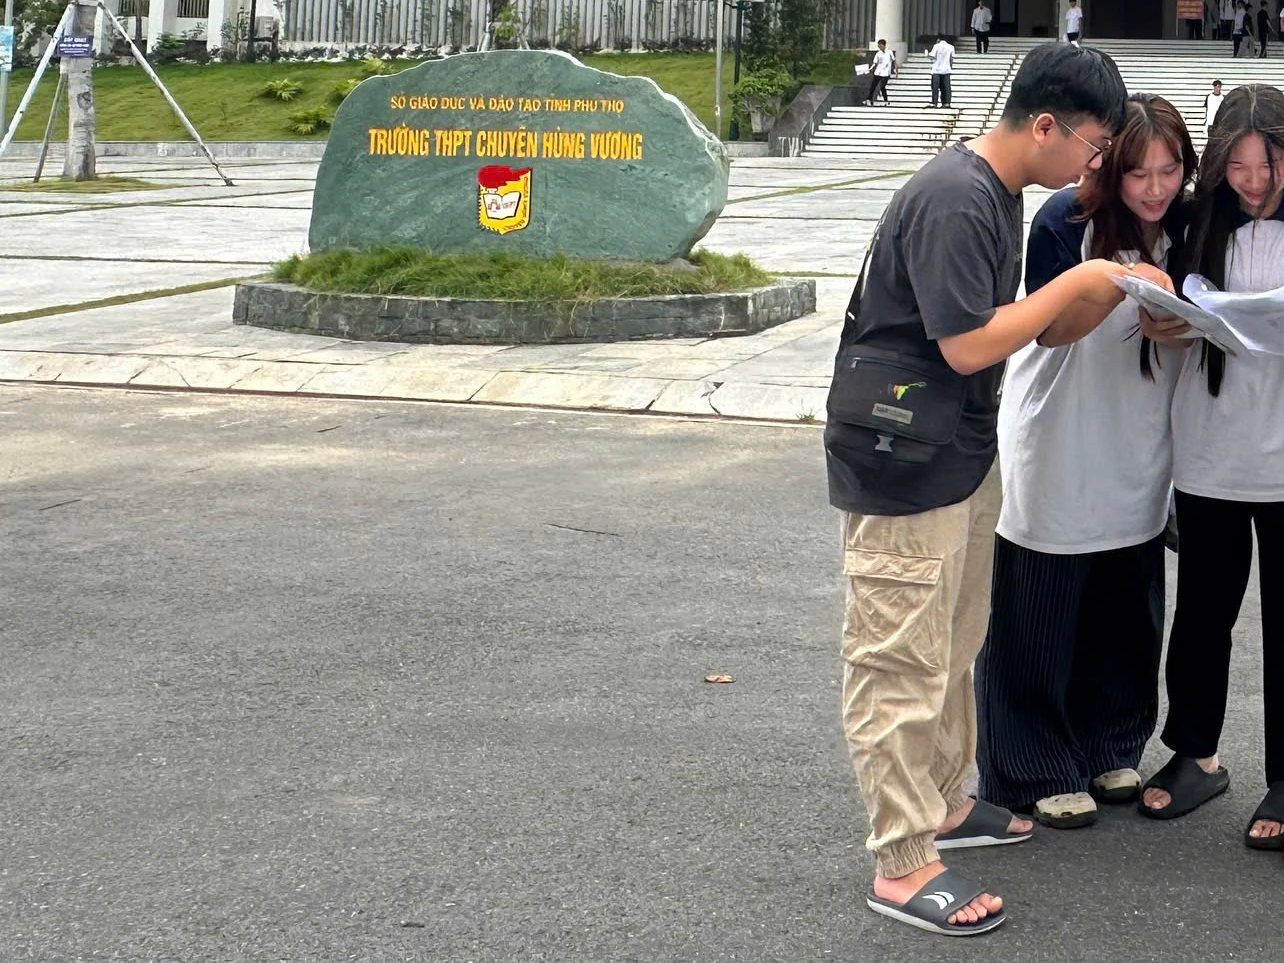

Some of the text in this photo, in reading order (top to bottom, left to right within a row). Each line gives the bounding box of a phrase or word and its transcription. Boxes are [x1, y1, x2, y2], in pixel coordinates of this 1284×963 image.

[409, 93, 438, 110] GIÁO
[434, 128, 472, 157] THPT
[475, 125, 538, 158] CHUYÊN
[591, 130, 643, 160] VƯƠNG
